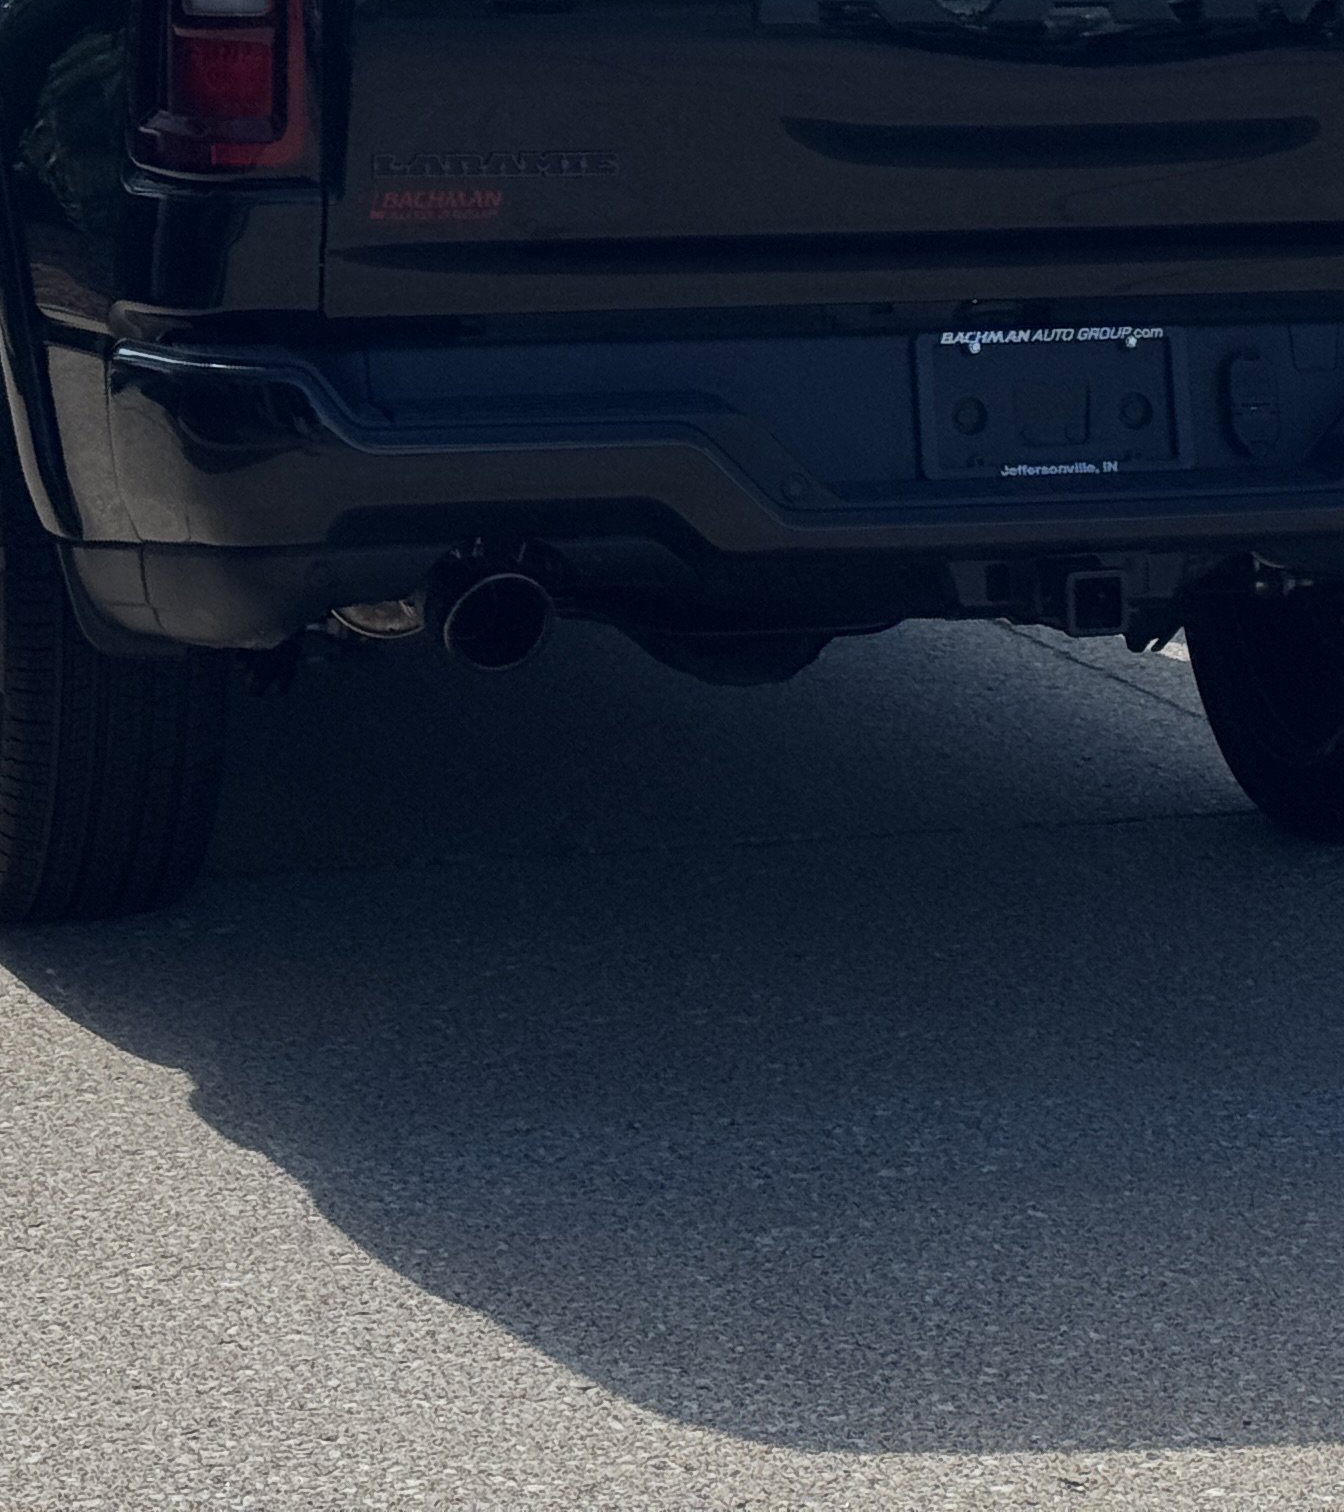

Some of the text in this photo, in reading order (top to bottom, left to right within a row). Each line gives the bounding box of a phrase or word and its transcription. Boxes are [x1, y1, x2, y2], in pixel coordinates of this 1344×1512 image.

[372, 151, 619, 178] LARAMIE
[382, 190, 503, 209] BACHMAN
[940, 329, 1031, 344] BACHMAN
[1031, 328, 1075, 342] AUTO
[1000, 460, 1118, 477] Jeffersonville, IN
